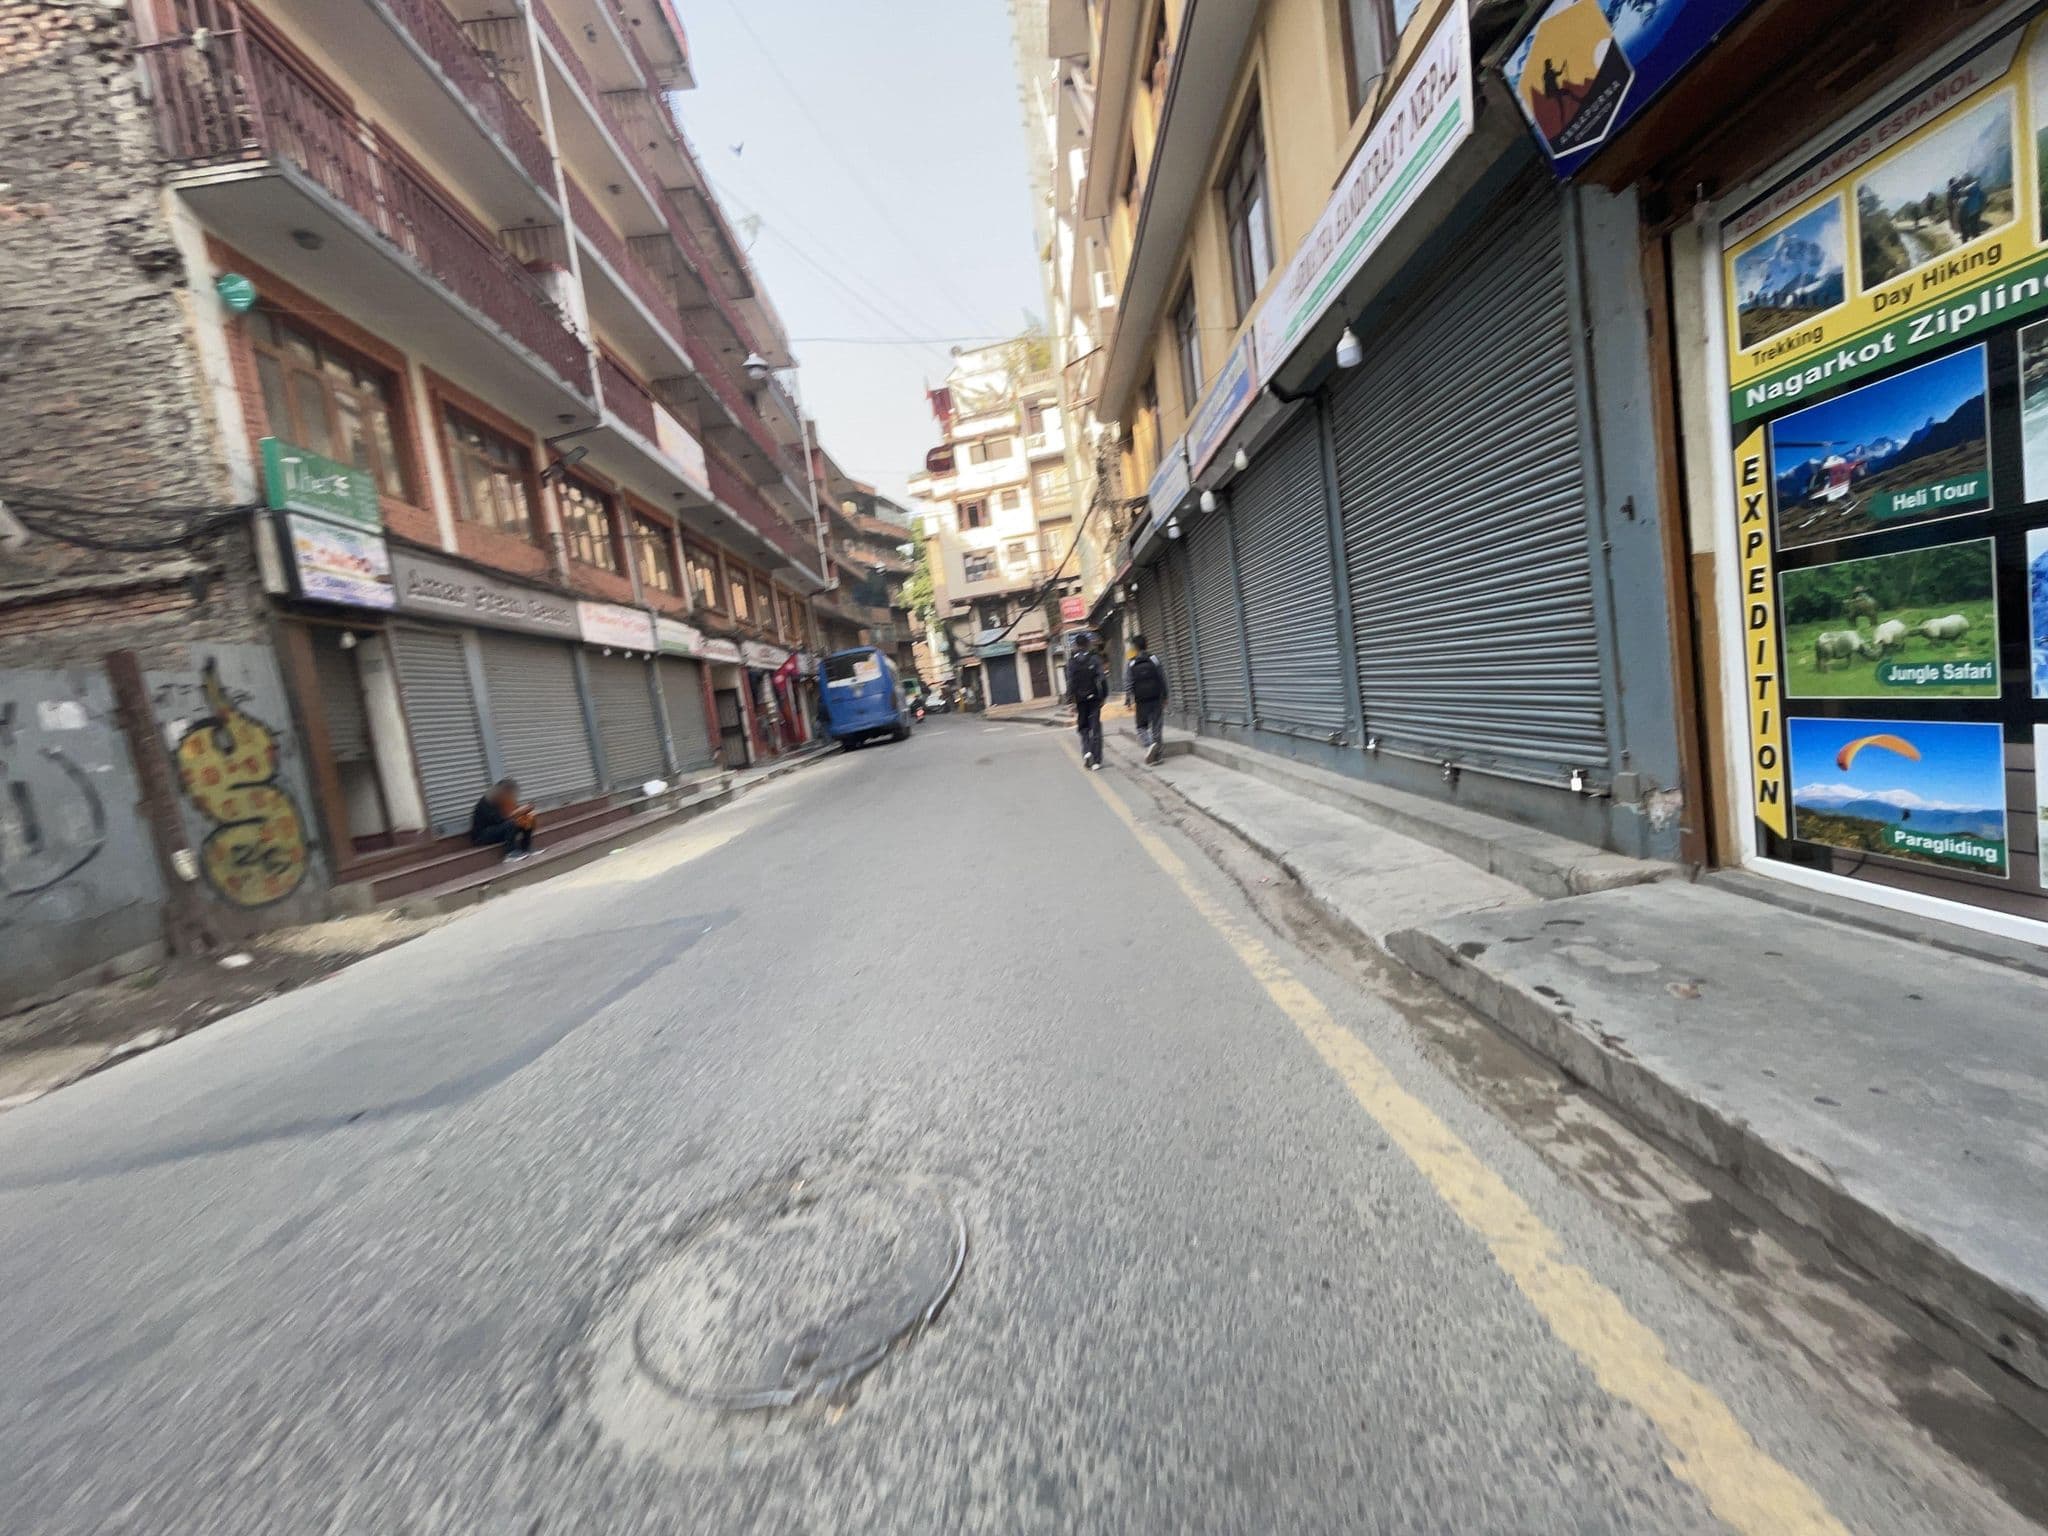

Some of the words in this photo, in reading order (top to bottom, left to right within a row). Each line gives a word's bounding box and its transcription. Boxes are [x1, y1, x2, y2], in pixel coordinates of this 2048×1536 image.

[1776, 137, 1872, 205] HABLAMOS
[1873, 282, 1914, 313] Day
[1922, 243, 2002, 290] Hiking
[1746, 331, 1896, 407] Nagarkot
[1908, 270, 2048, 344] Ziplin
[1752, 326, 1823, 366] Trekking
[1892, 490, 1928, 512] Heli
[1932, 480, 1978, 502] Tour
[1742, 456, 1779, 804] EXPEDITION
[1888, 664, 1939, 685] Jungle
[1943, 662, 1992, 681] Safari
[1894, 830, 1998, 863] Paragliding
